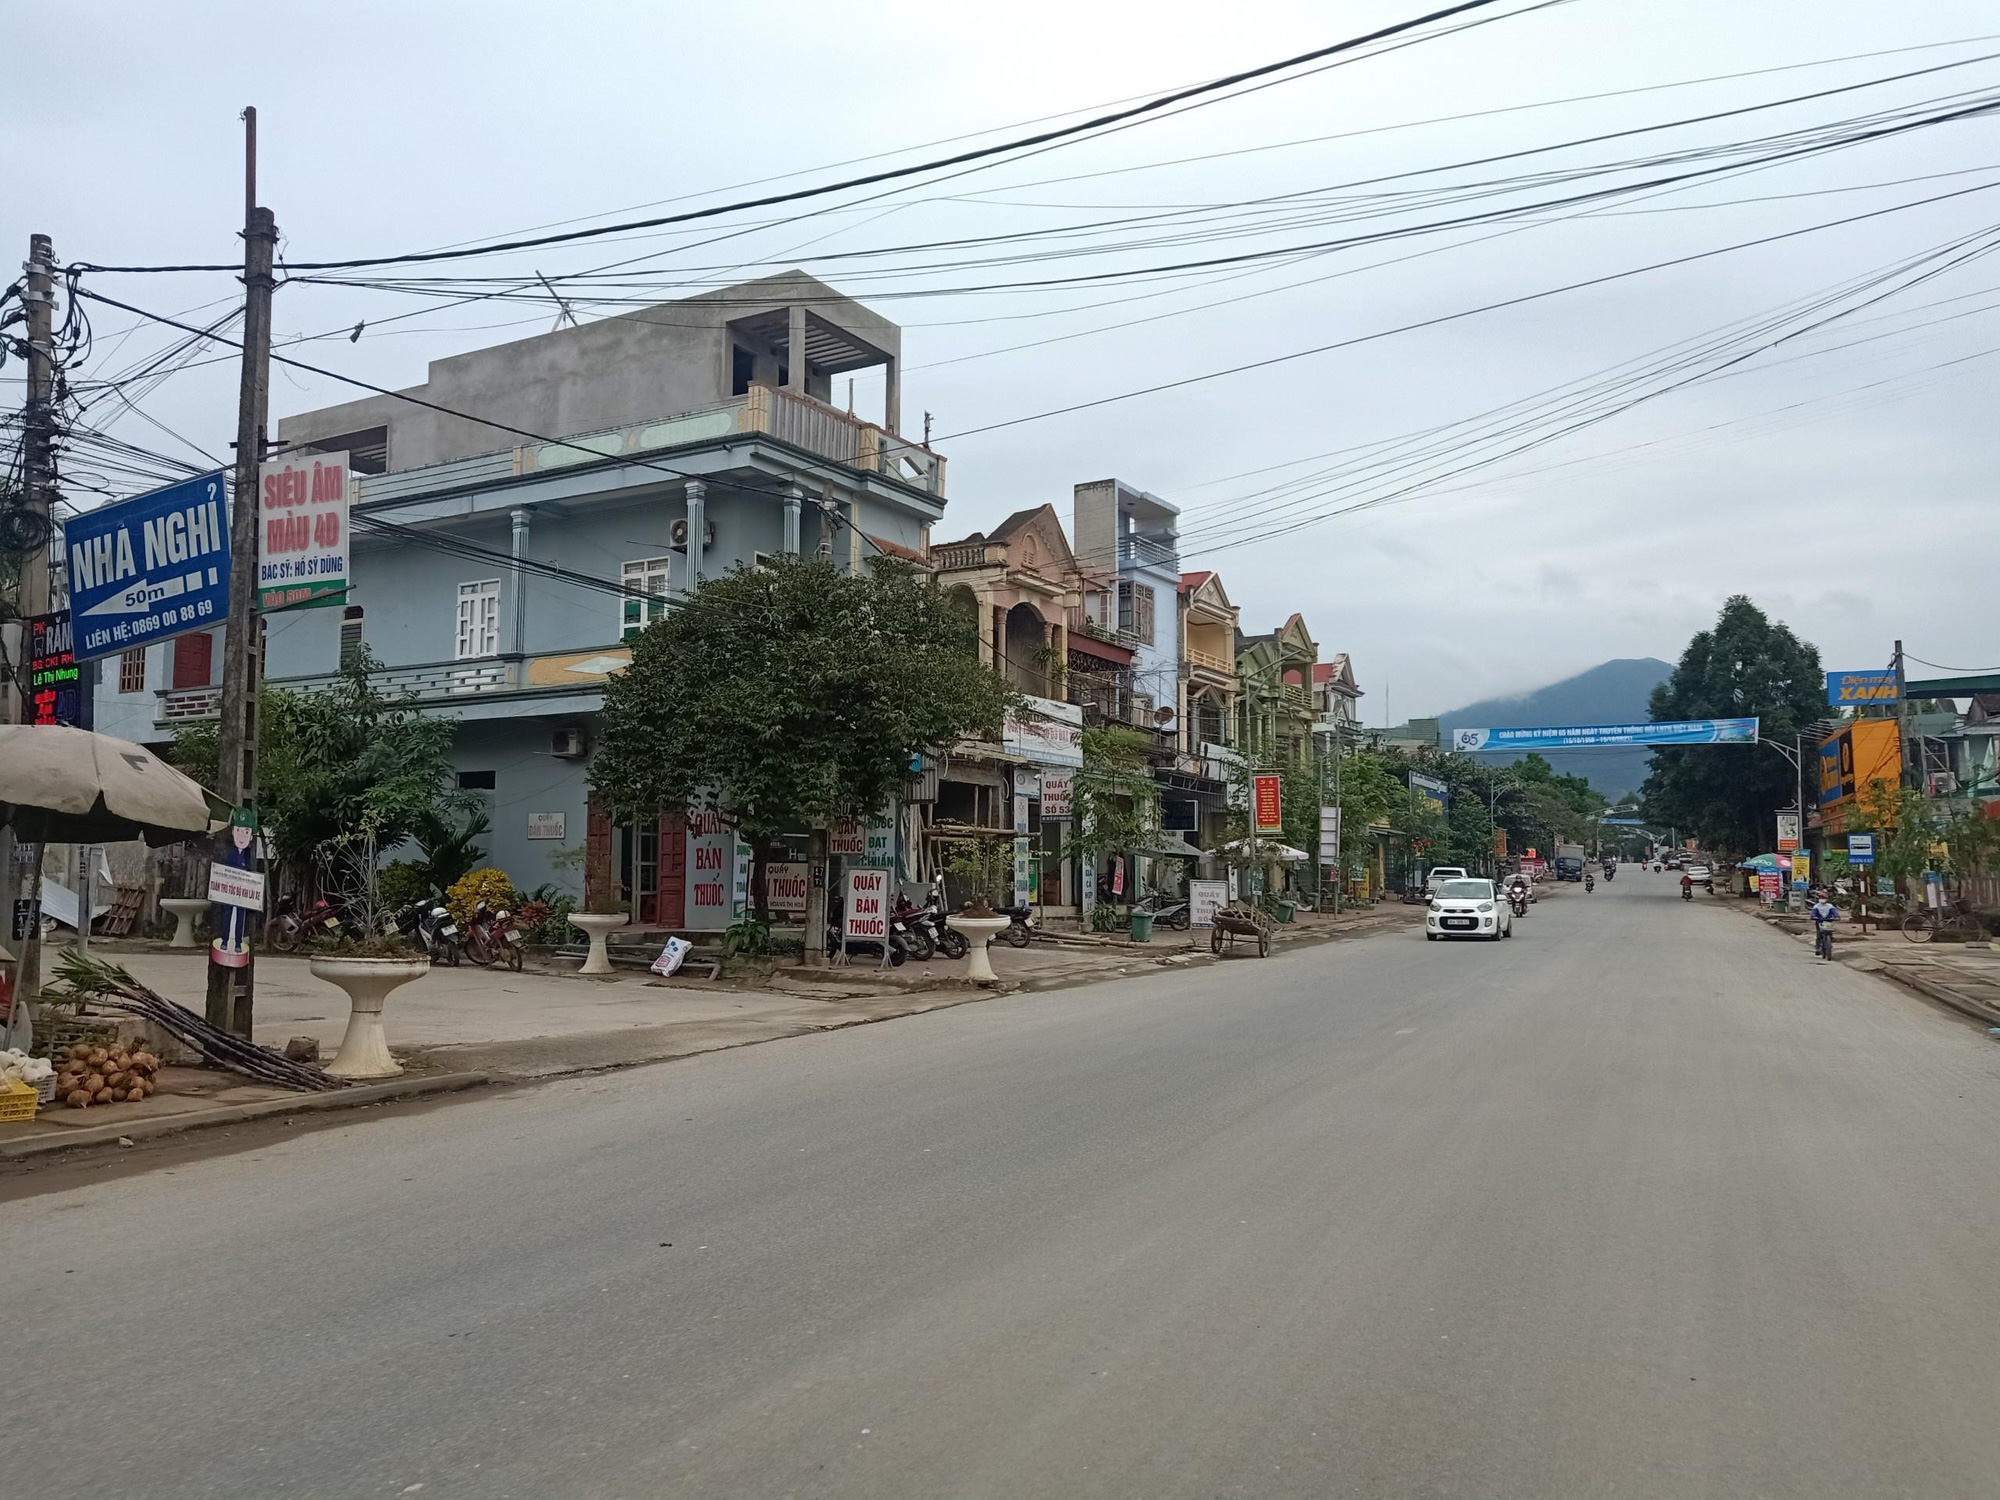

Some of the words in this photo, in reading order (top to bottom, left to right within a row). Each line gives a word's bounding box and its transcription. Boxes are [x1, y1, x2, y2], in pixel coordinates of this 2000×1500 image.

[264, 465, 307, 510] SIÊU
[311, 461, 343, 504] ÂM
[143, 482, 221, 571] NGHỈ
[267, 510, 310, 555] MÀU
[314, 512, 340, 548] 4D
[262, 562, 278, 581] BÁC
[320, 555, 343, 574] DŨNG
[125, 586, 165, 607] 50m
[46, 616, 73, 655] RĂN
[85, 625, 111, 649] LIÊN
[162, 611, 177, 627] 00
[180, 606, 195, 622] 88
[197, 599, 213, 617] 69
[33, 673, 42, 686] Lê
[55, 667, 79, 681] Nhung
[1838, 685, 1898, 700] XANH
[1058, 806, 1070, 814] 53
[695, 840, 723, 870] BÁN
[831, 835, 863, 852] THUỐC
[868, 836, 887, 851] ĐẠT
[693, 872, 724, 907] THUỐC
[773, 873, 806, 898] THUỐC
[856, 896, 879, 914] BÁN
[849, 915, 884, 935] THUỐC
